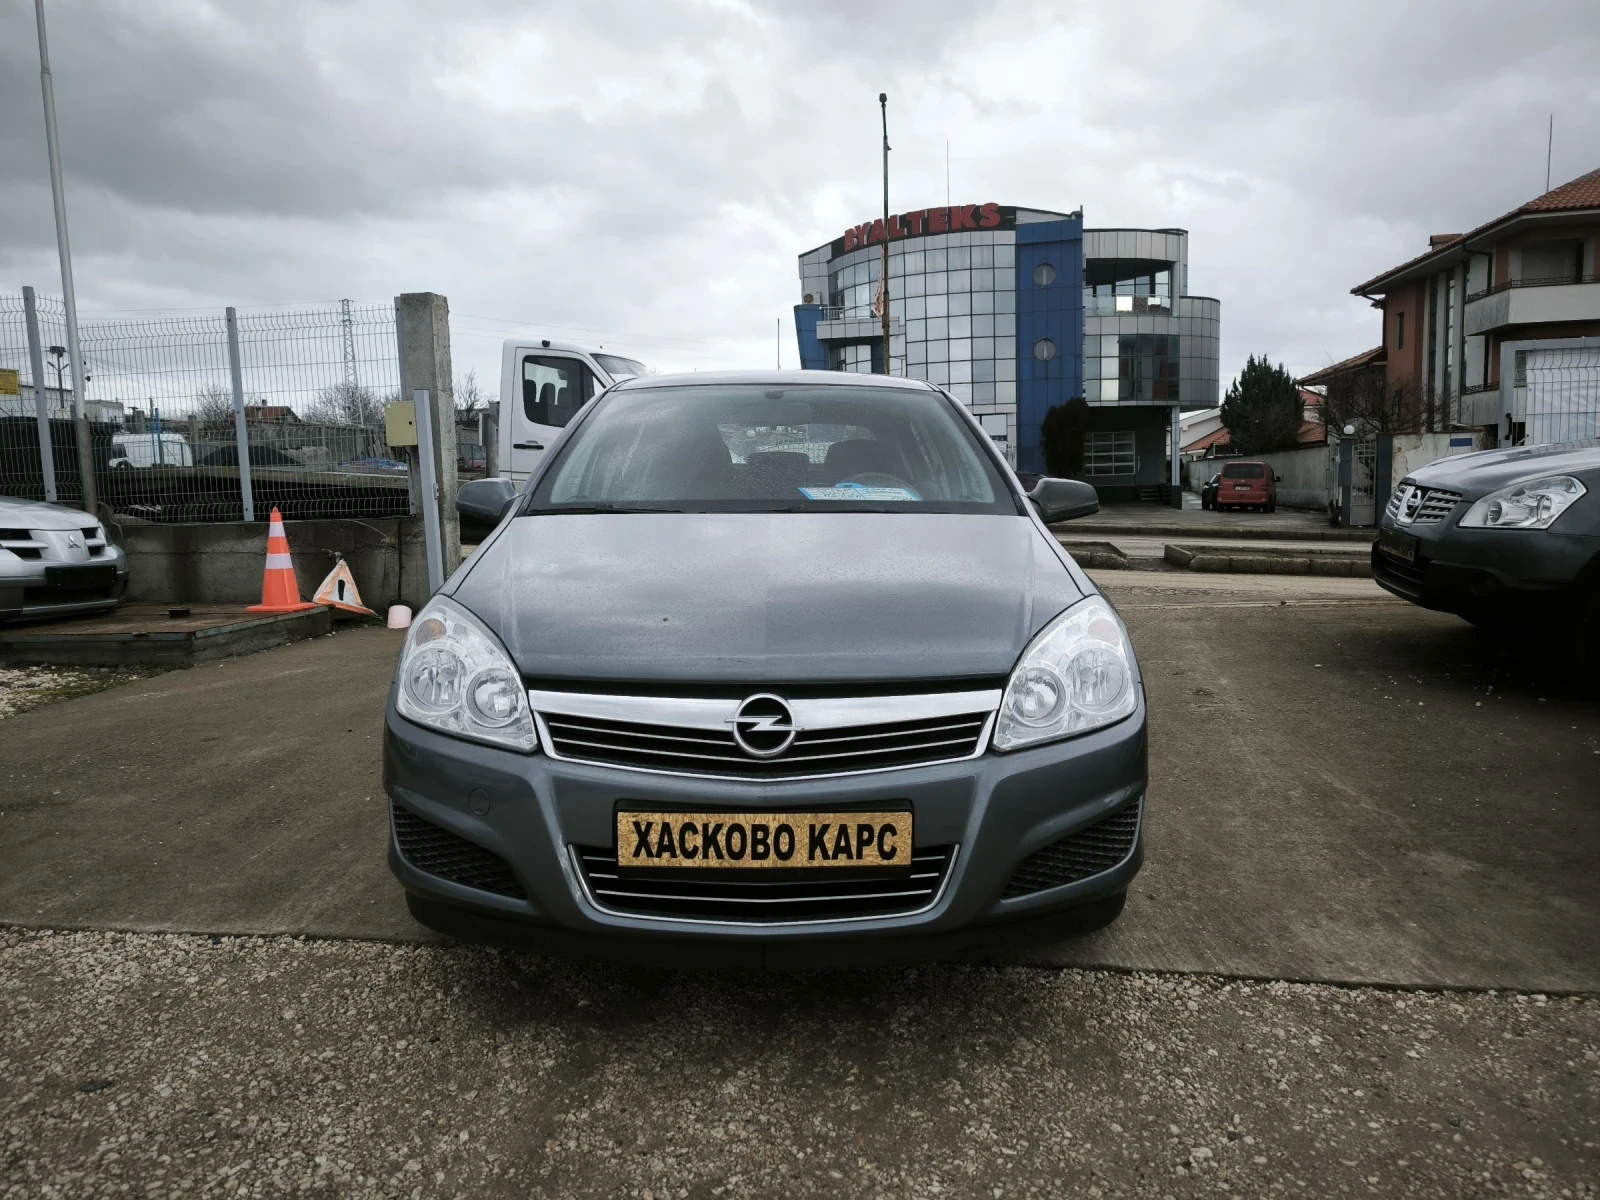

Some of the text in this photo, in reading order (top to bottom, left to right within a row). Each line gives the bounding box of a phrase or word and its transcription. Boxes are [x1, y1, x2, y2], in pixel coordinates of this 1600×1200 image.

[844, 202, 1000, 252] BYALTEKS
[632, 821, 898, 861] ХАСКОВО КАРС
